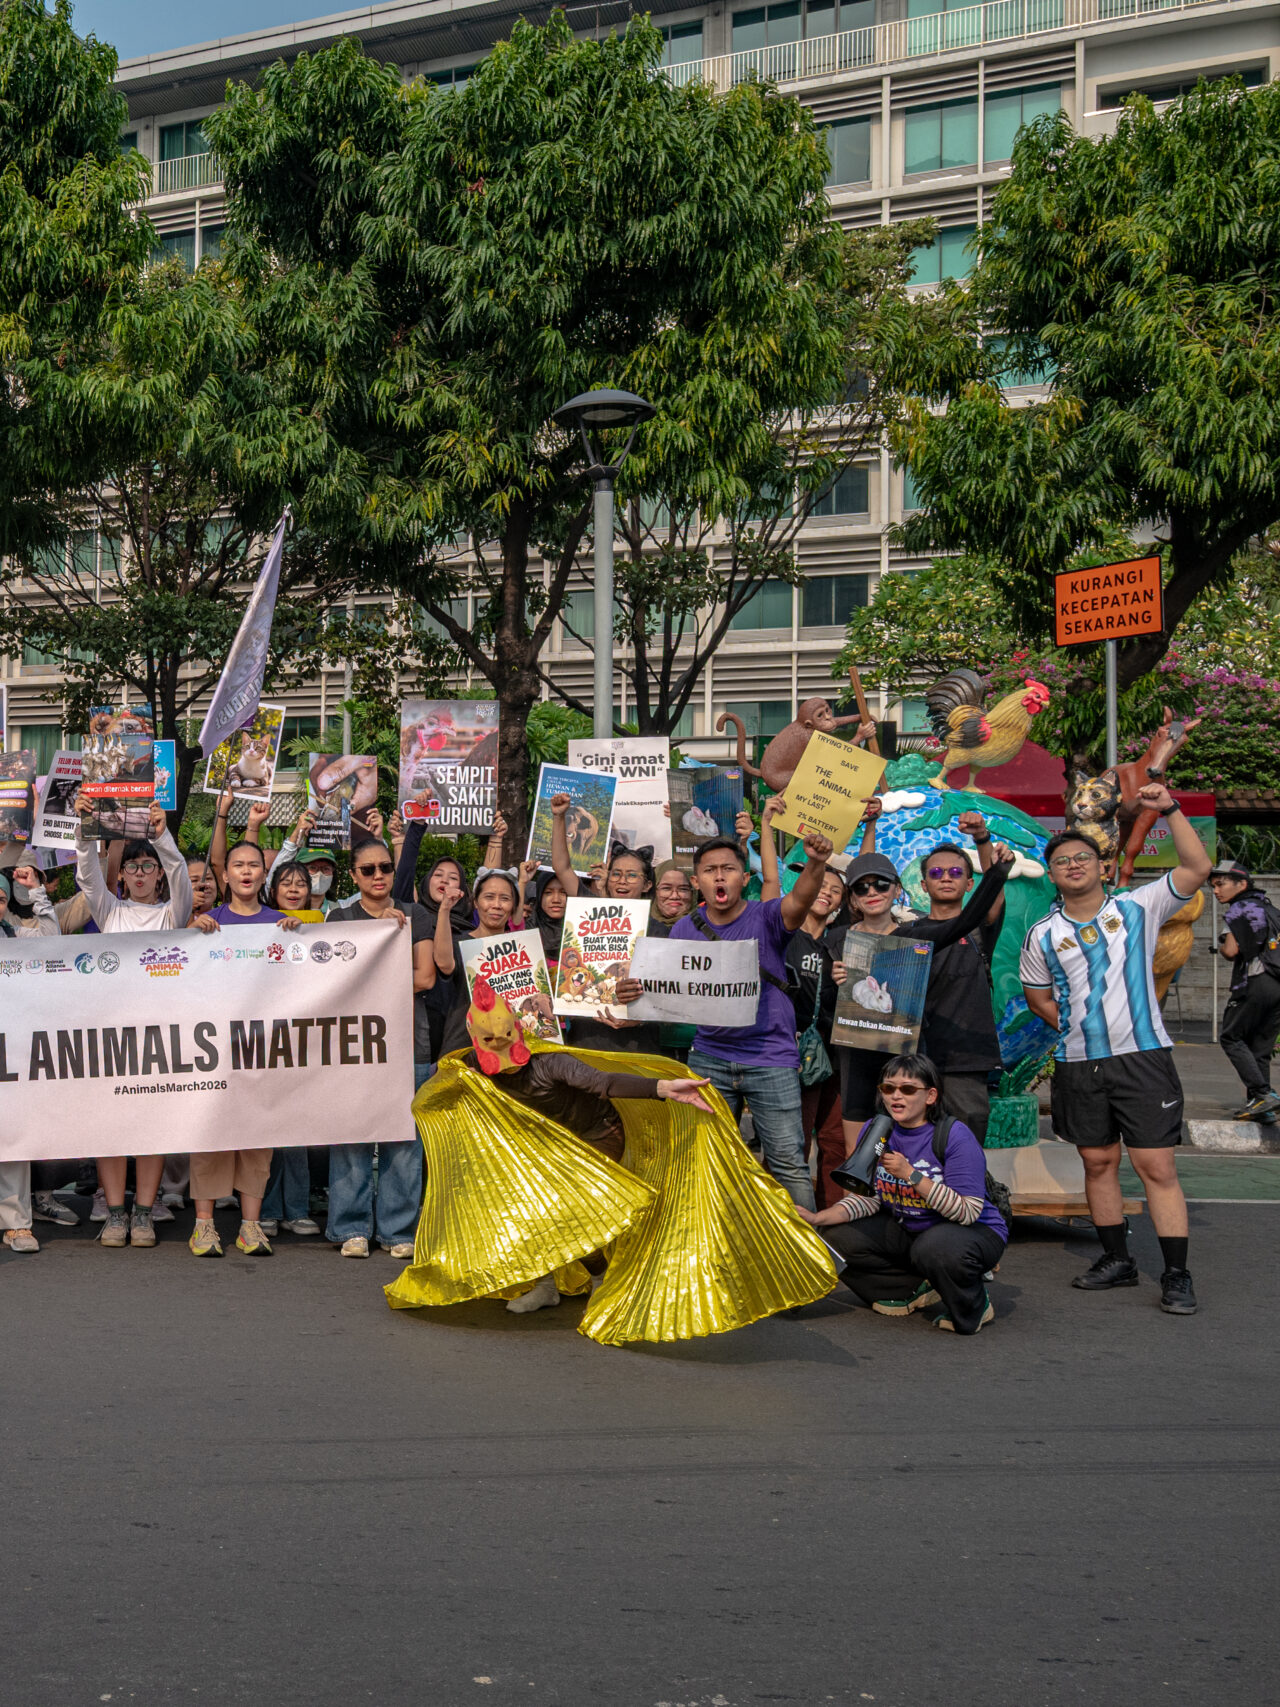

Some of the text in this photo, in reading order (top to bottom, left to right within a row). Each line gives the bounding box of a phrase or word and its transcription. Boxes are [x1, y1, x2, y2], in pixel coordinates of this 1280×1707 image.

[1070, 569, 1142, 594] KURANGI
[1060, 589, 1154, 616] KECEPATAN
[1065, 610, 1152, 635] SEKARANG
[817, 734, 852, 753] TRYING TO
[620, 754, 665, 764] amat
[840, 760, 859, 772] SAVE
[437, 766, 494, 785] SEMPIT
[815, 766, 833, 778] THE
[546, 783, 570, 791] HEWAN
[818, 778, 852, 798] ANIMAL
[448, 786, 494, 806] SAKIT
[796, 794, 826, 811] MY LAST
[812, 792, 832, 805] WITH
[54, 820, 75, 829] BATTERY
[797, 812, 839, 833] 2% BATTERY
[44, 830, 62, 838] CHOOSE
[588, 906, 623, 920] JADI
[578, 918, 632, 937] SUARA
[583, 944, 606, 952] TIDAK
[584, 936, 628, 944] BUAT YANG
[236, 950, 246, 958] 21
[486, 940, 518, 961] JADI
[582, 952, 630, 962] BERSUARA.
[146, 962, 184, 972] ANIMAL
[480, 950, 530, 980] SUARA
[681, 956, 712, 971] END
[150, 970, 180, 978] MARCH
[488, 969, 532, 986] BUAT YANG
[493, 978, 534, 992] TIDAK BISA
[688, 981, 758, 998] EXPLOITATION
[838, 1016, 912, 1035] Hewan Bukan Komoditas.
[28, 1020, 220, 1080] ANIMALS
[230, 1014, 388, 1070] MATTER
[113, 1079, 228, 1097] #AnimalsMarch2026
